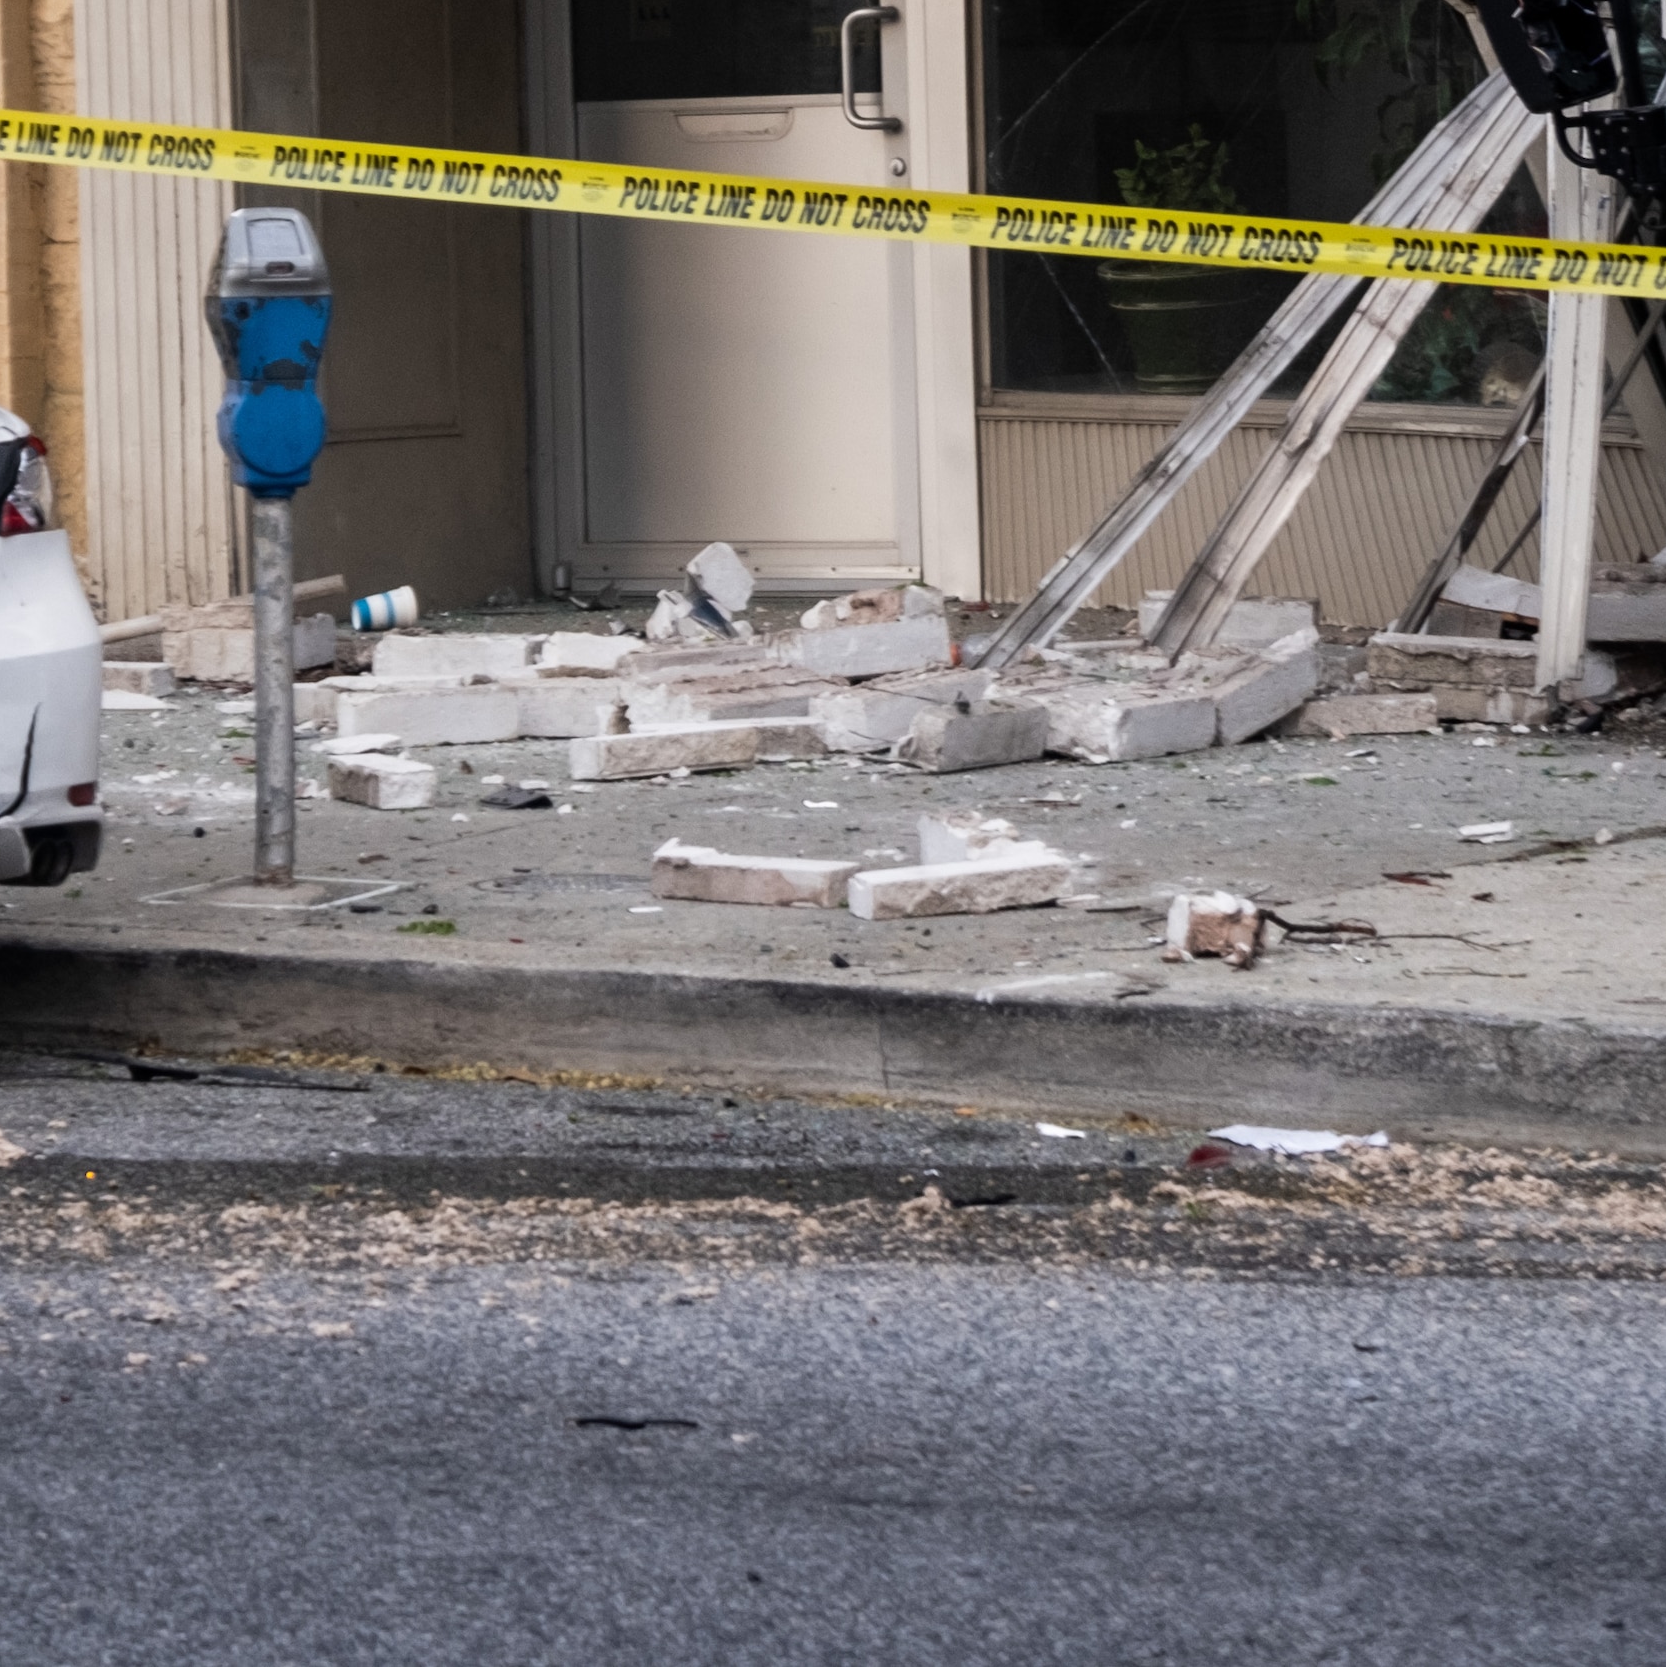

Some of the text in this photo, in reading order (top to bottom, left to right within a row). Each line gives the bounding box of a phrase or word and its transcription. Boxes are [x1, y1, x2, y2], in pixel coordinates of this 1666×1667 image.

[15, 121, 60, 156] LINE
[65, 127, 95, 159] DO
[99, 130, 142, 164] NOT
[147, 134, 215, 170] CROSS
[270, 146, 346, 182] POLICE
[350, 153, 399, 188] LINE
[404, 158, 434, 191] DO
[438, 161, 485, 195] NOT
[489, 165, 562, 202] CROSS
[619, 176, 699, 214] POLICE
[704, 184, 756, 219] LINE
[760, 188, 794, 222] DO
[799, 191, 847, 226] NOT
[852, 195, 931, 233] CROSS
[992, 207, 1076, 245] POLICE
[1081, 214, 1137, 250] LINE
[1142, 219, 1178, 253] DO
[1182, 223, 1234, 257] NOT
[1239, 226, 1323, 264] CROSS
[1387, 237, 1479, 275] POLICE
[1485, 243, 1544, 280] LINE
[1549, 249, 1588, 283] DO
[1593, 252, 1648, 287] NOT
